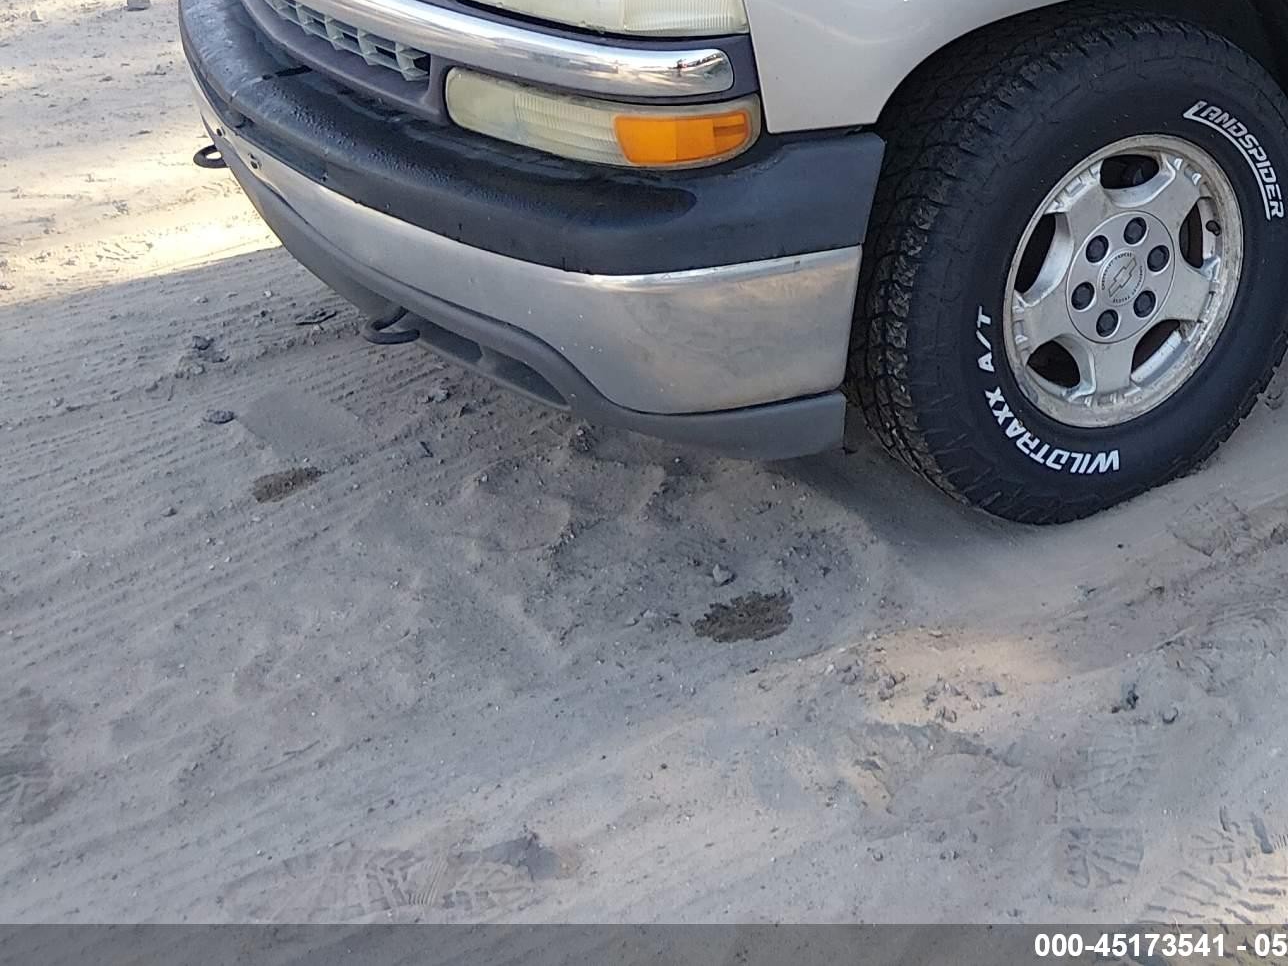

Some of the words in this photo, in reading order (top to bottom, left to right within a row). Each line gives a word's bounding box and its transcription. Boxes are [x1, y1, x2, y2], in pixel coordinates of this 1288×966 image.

[1183, 100, 1284, 221] LANDSPIDER
[975, 305, 995, 372] A/T
[984, 386, 1120, 474] WILDTRAXX
